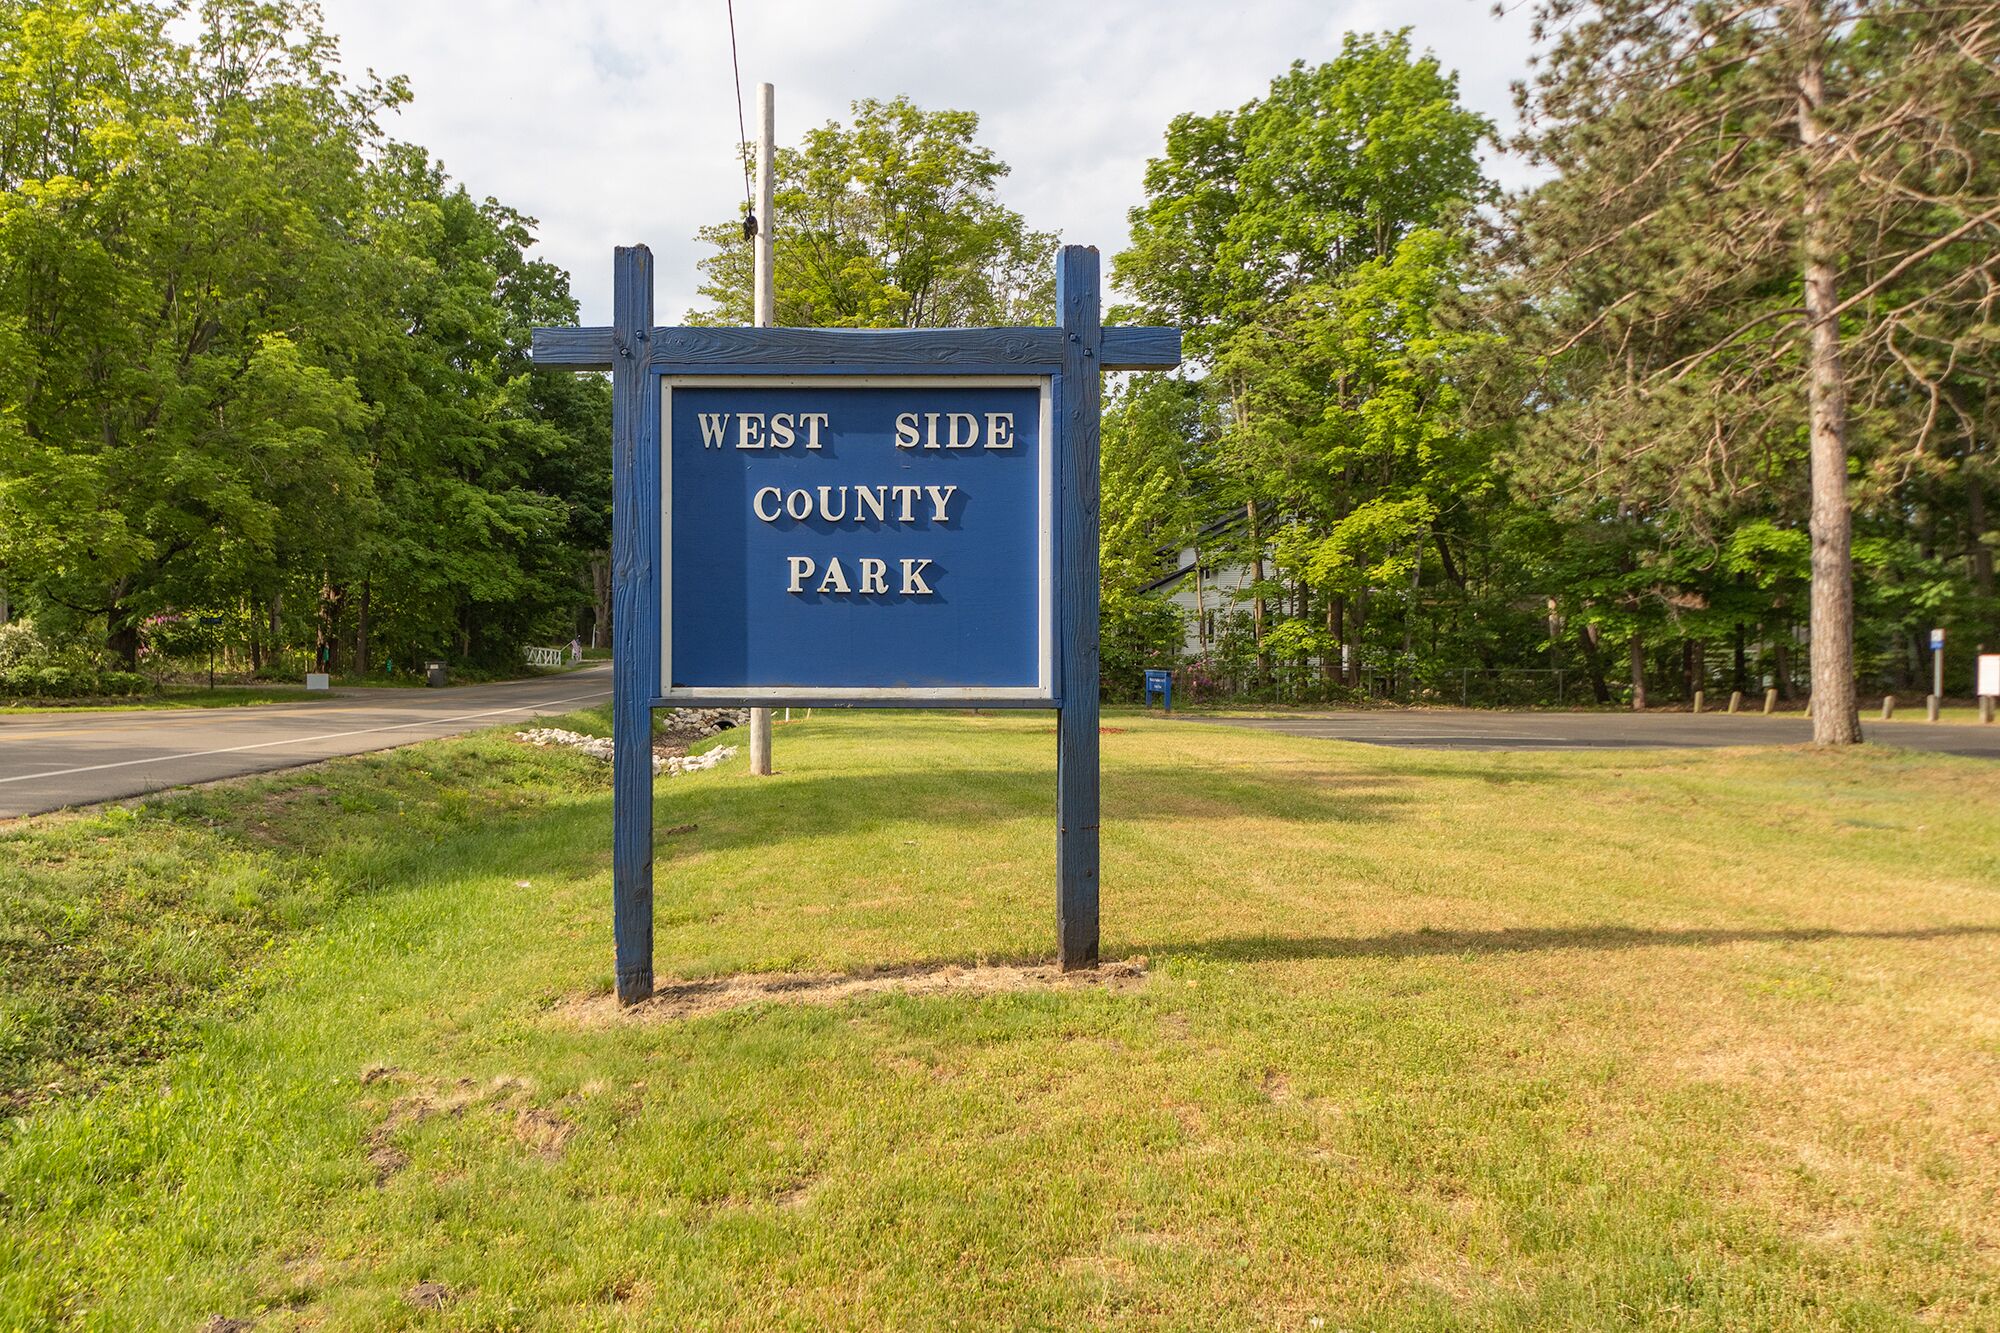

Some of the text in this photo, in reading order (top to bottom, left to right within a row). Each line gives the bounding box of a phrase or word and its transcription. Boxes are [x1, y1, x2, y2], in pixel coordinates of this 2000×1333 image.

[698, 412, 1014, 450] WEST SIDE
[753, 485, 957, 522] COUNTY
[787, 556, 933, 595] PARK
